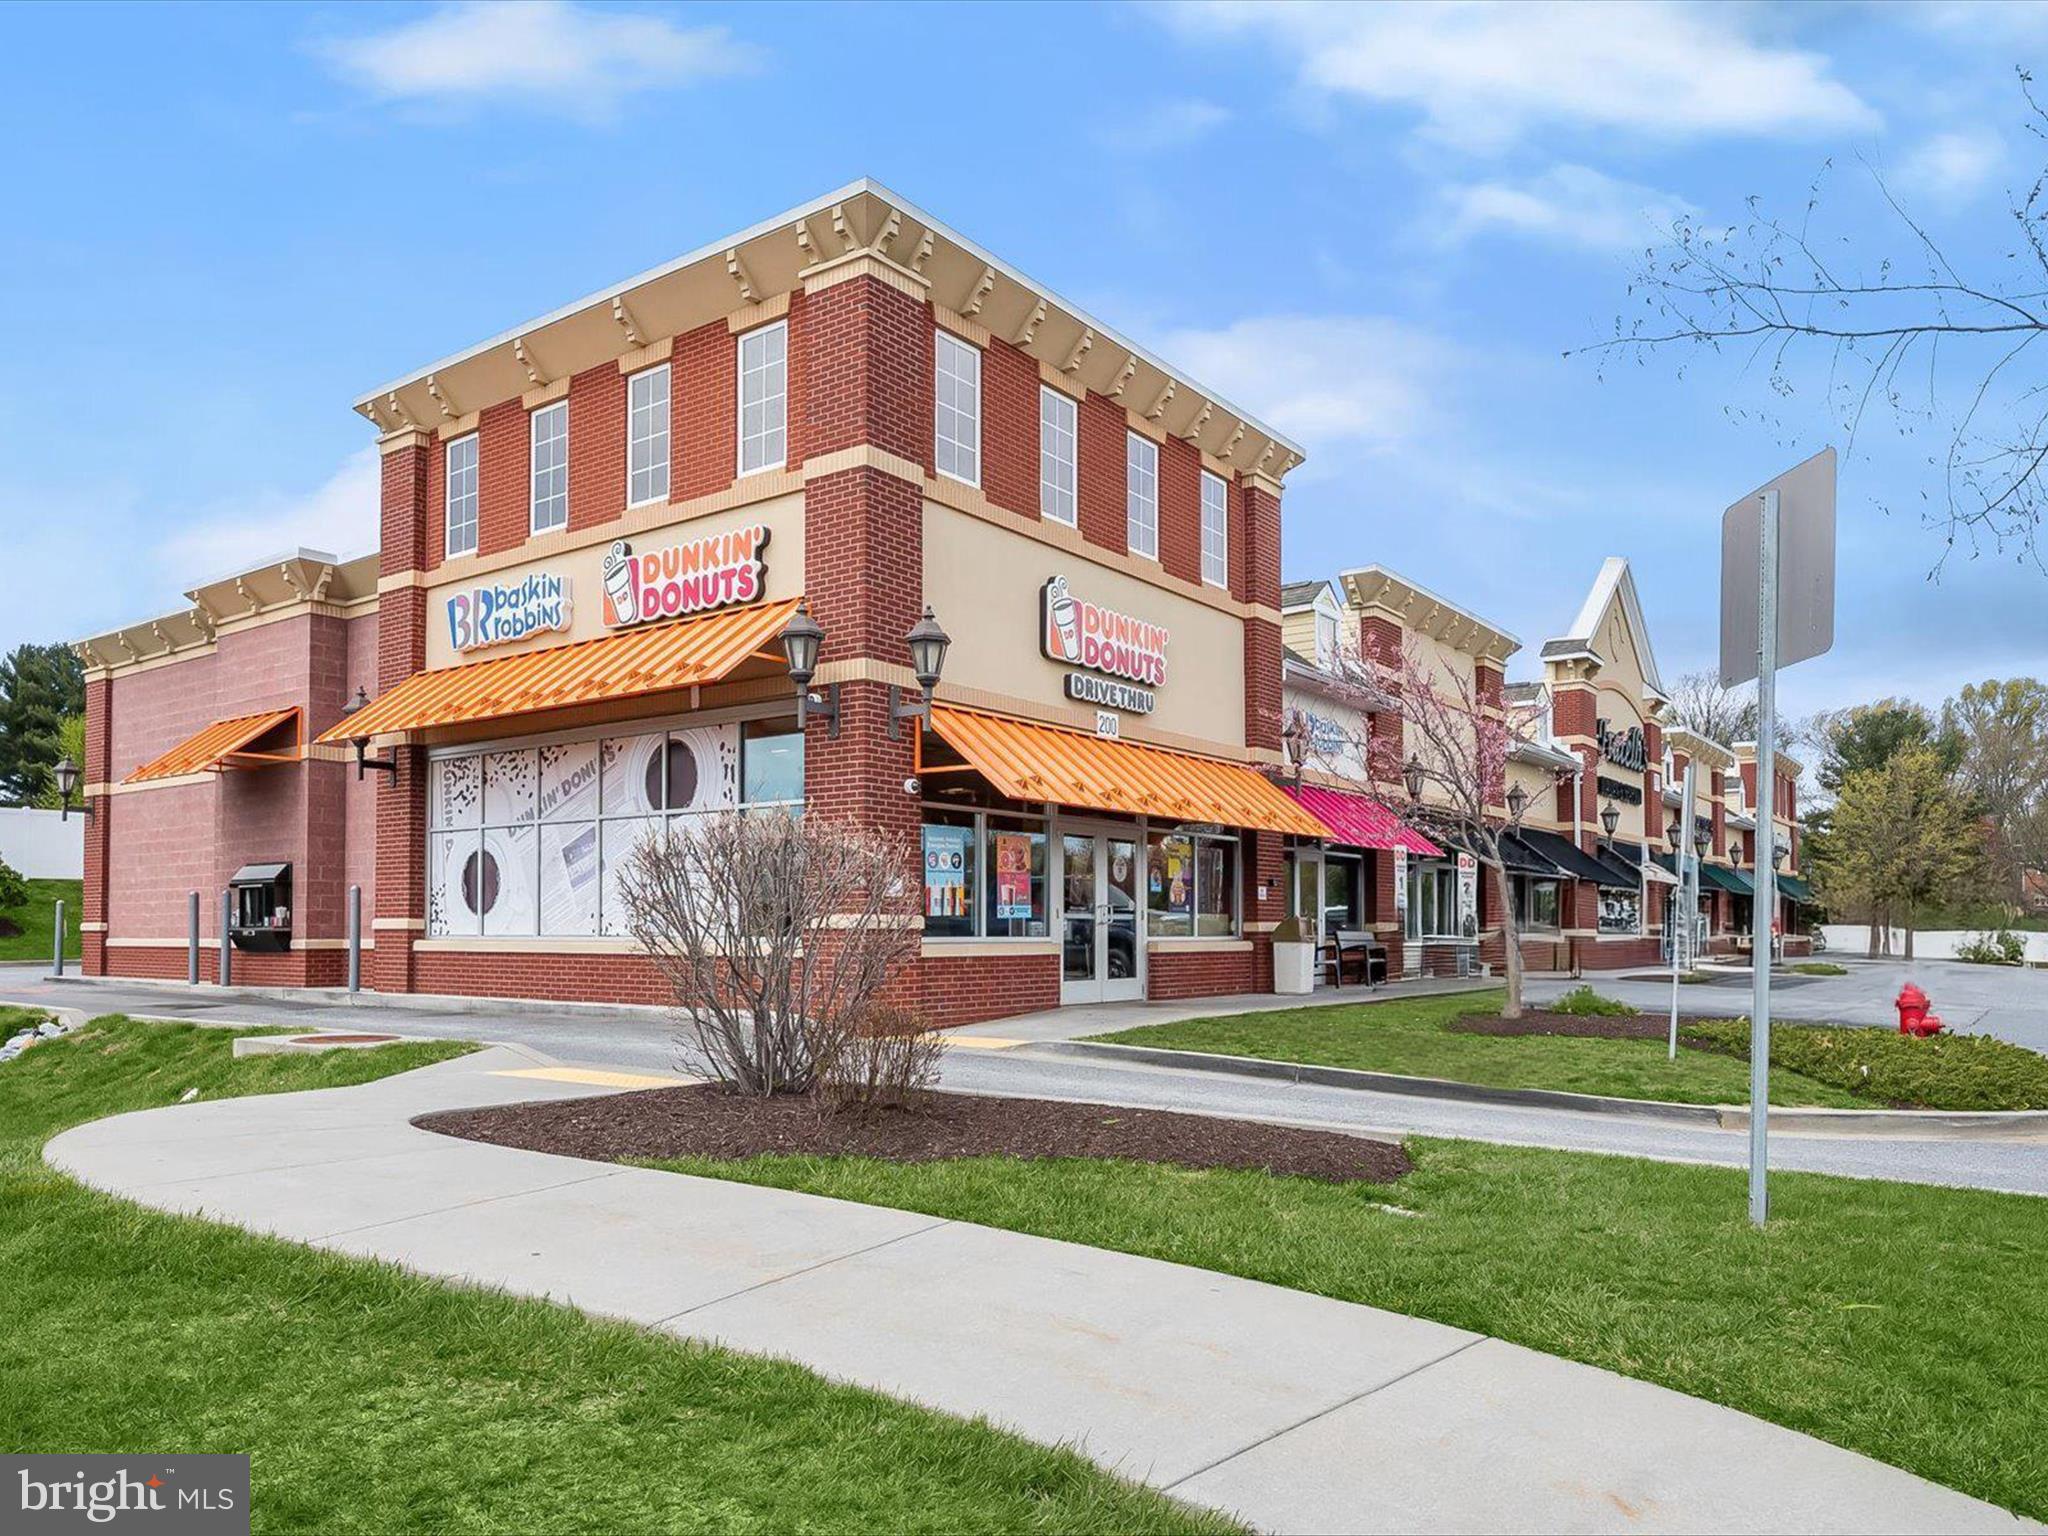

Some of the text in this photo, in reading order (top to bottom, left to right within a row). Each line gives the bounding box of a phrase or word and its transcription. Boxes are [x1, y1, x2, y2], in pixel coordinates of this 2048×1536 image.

[643, 526, 760, 585] DUNKIN'
[494, 573, 561, 612] baskin
[643, 564, 754, 618] DONUTS
[447, 589, 494, 649] BR
[494, 601, 561, 639] robbins
[1084, 604, 1168, 655] DUNKIN'
[1084, 635, 1165, 685] DONUTS
[1098, 715, 1117, 735] 200
[507, 786, 560, 839] DUNIN'
